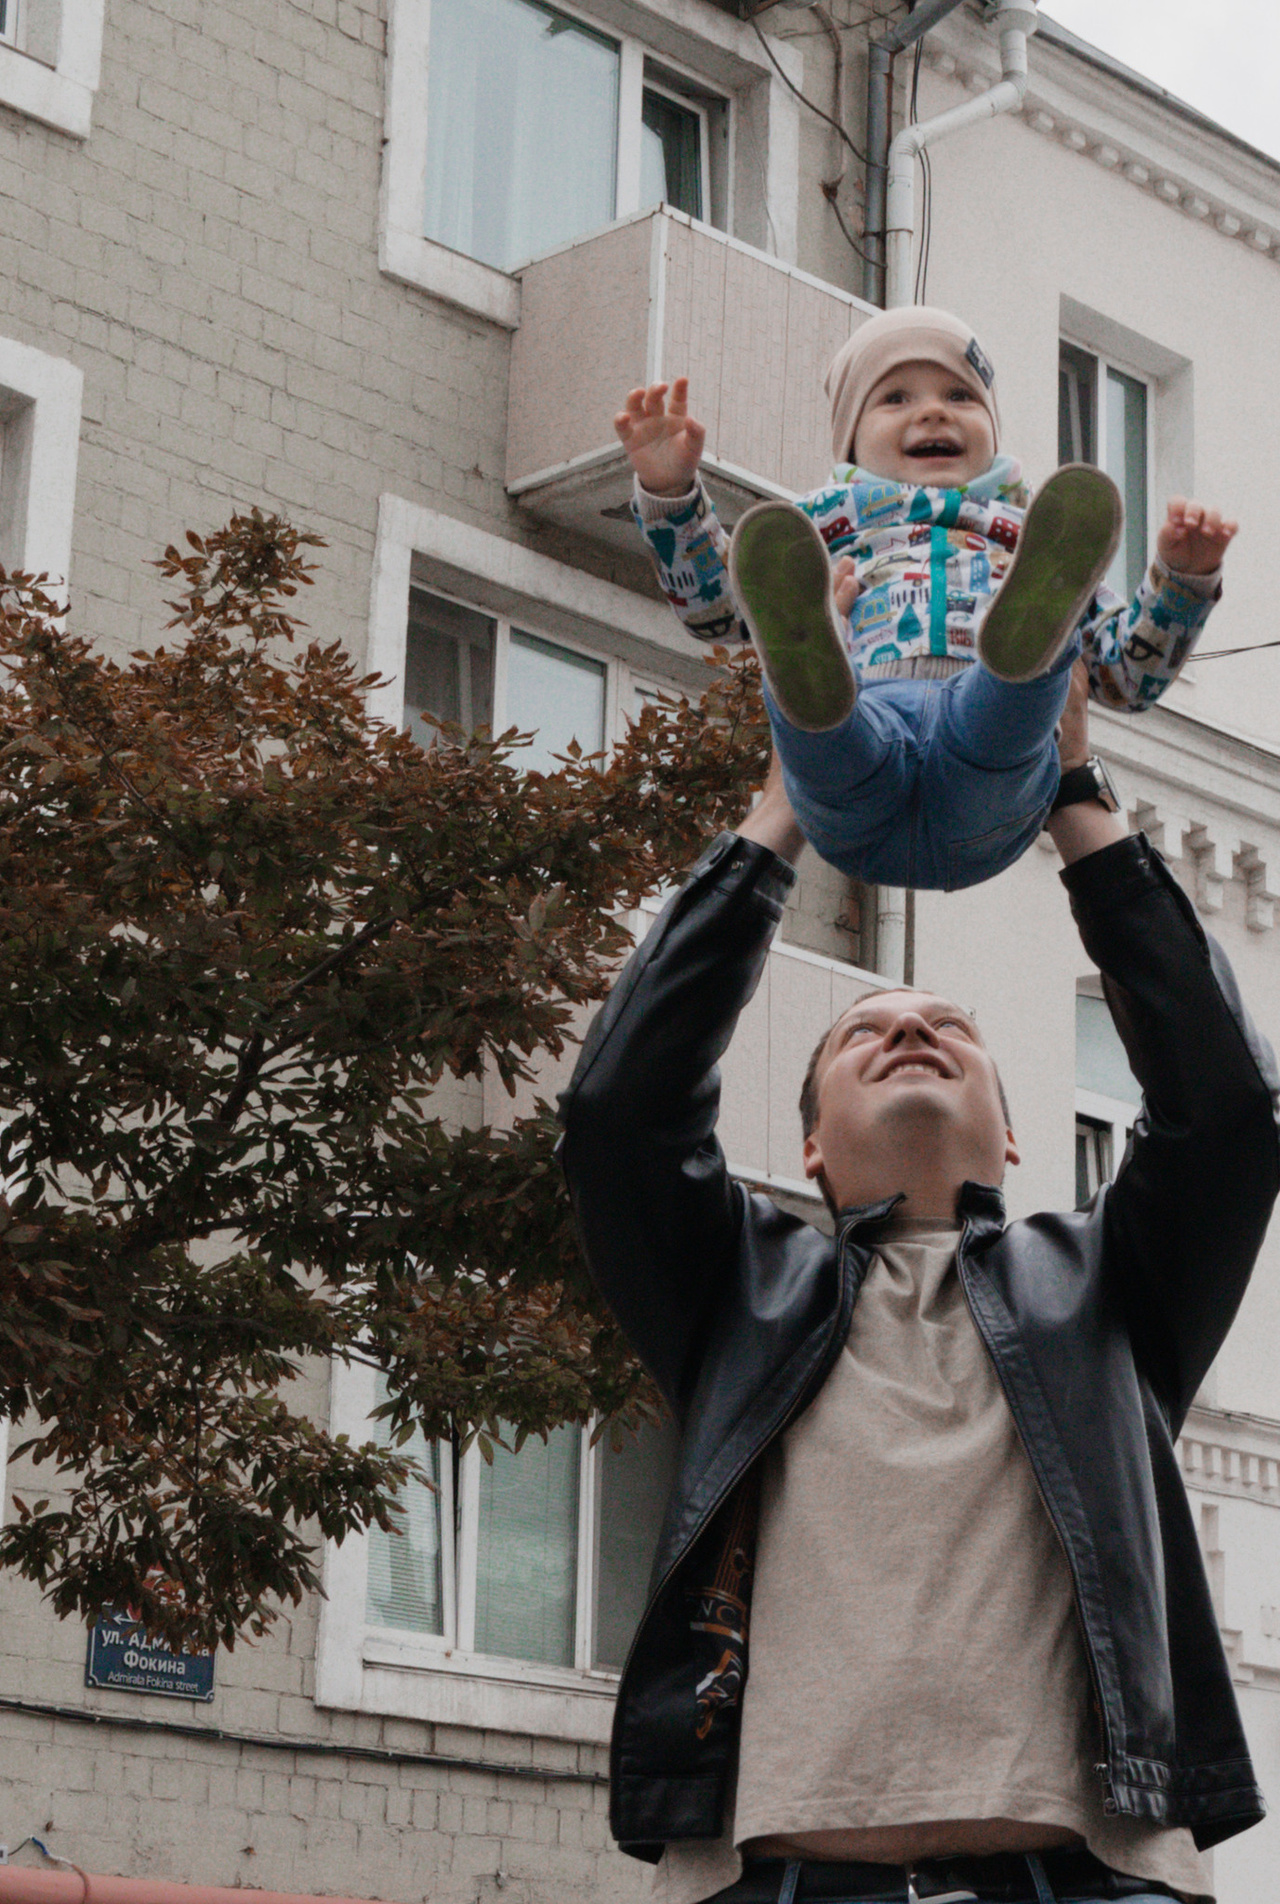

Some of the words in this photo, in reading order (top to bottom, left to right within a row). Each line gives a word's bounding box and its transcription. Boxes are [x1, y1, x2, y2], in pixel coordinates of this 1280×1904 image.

[101, 1629, 124, 1647] ул.
[123, 1650, 186, 1675] Фокина
[107, 1671, 145, 1686] Admirala
[146, 1675, 174, 1690] Fokina
[176, 1680, 199, 1693] street
